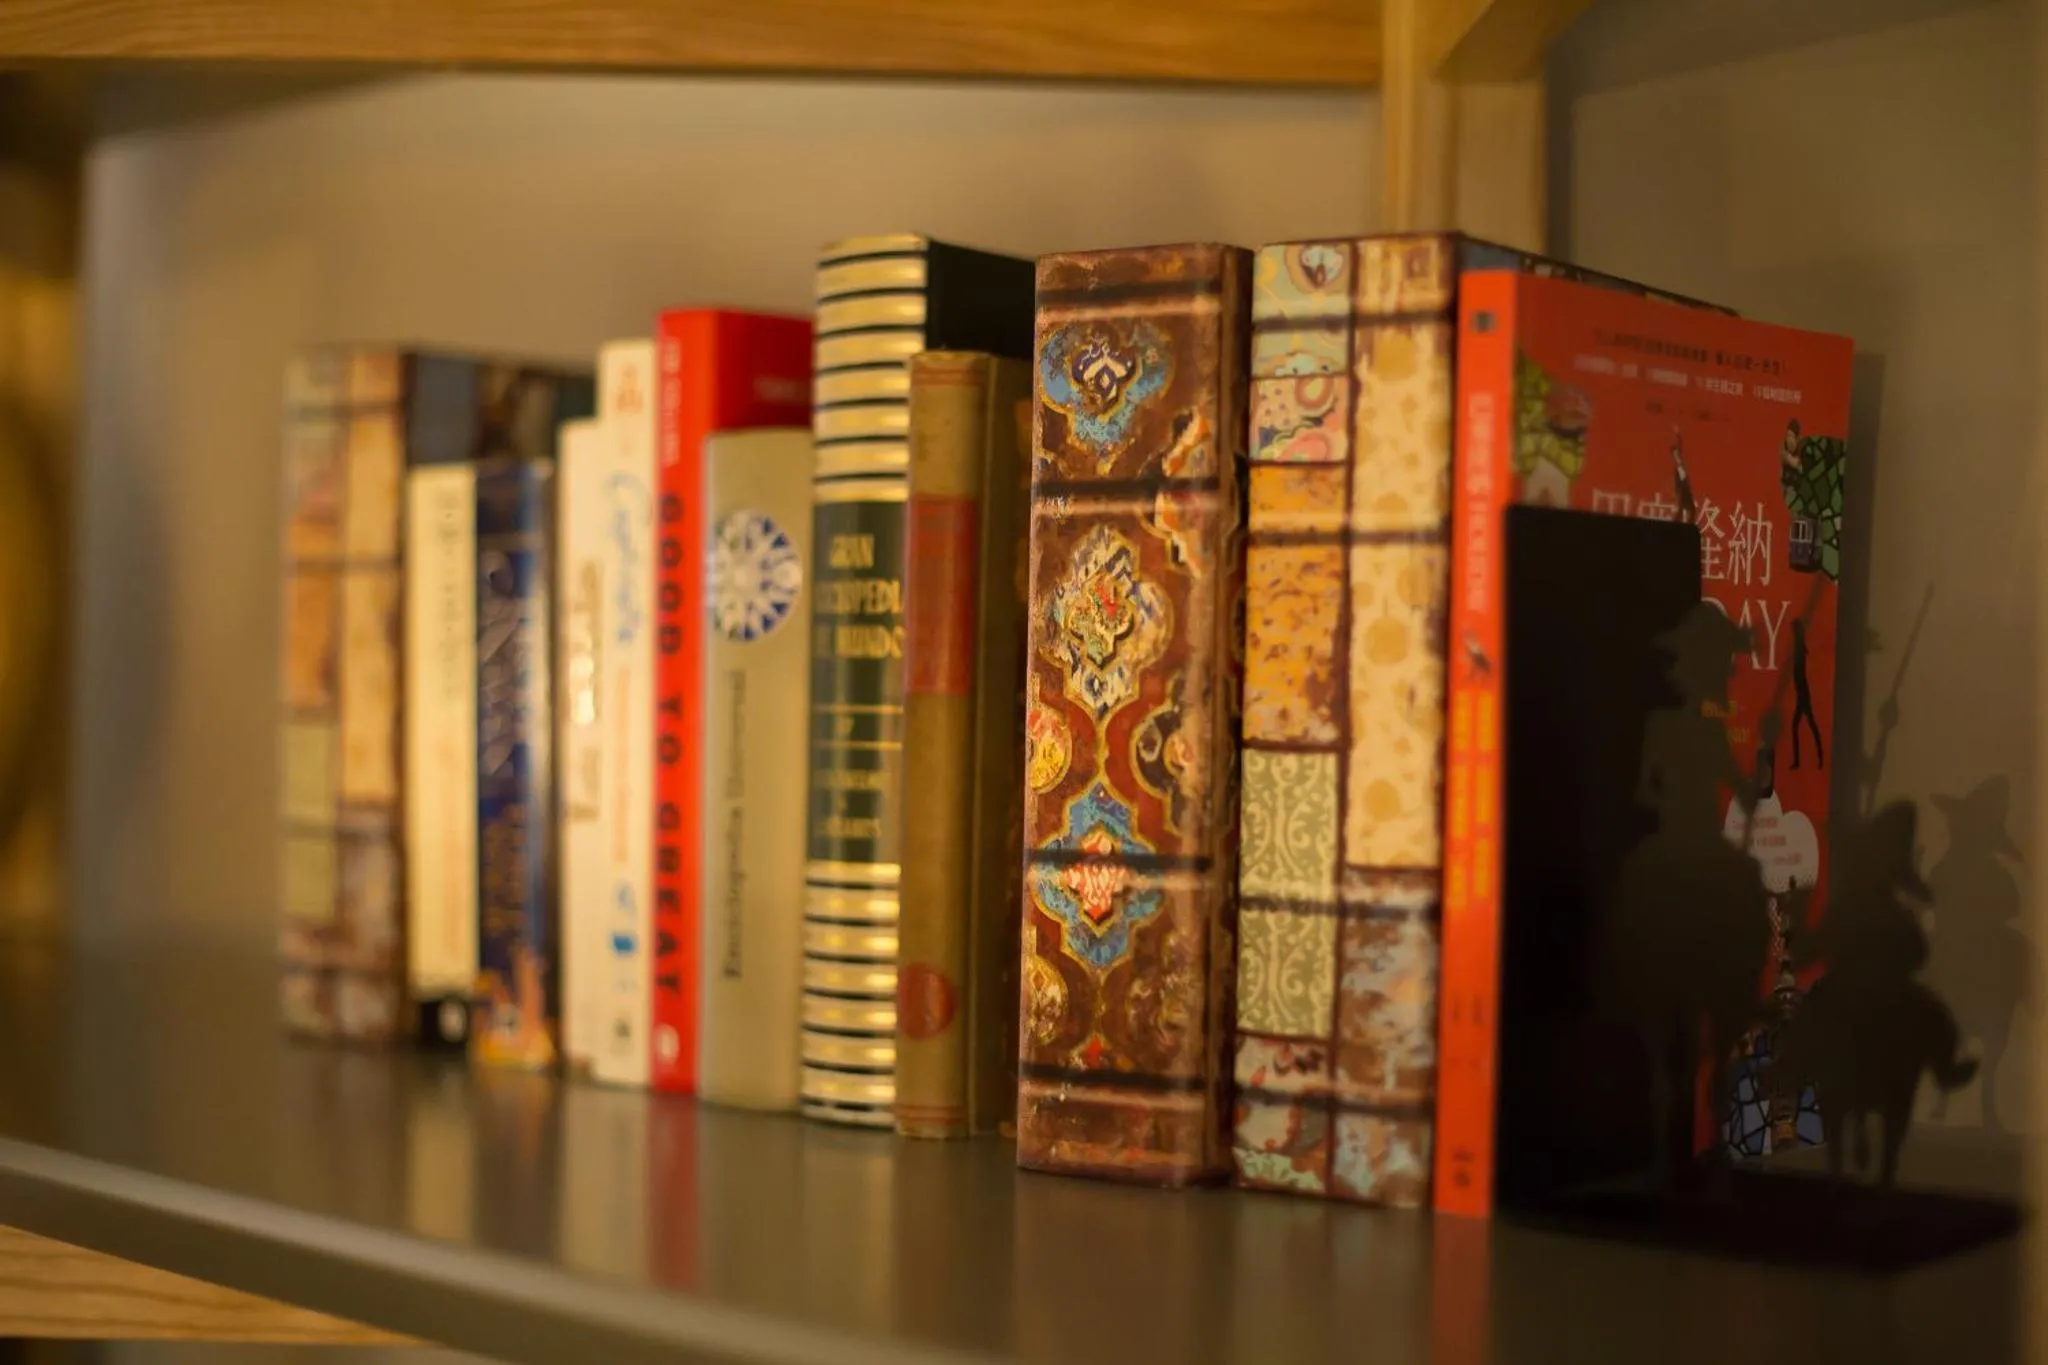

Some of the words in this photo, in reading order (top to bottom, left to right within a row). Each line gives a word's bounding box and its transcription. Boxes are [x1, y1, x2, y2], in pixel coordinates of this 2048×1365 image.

[659, 493, 684, 656] GOOD
[1591, 488, 1774, 587] 隆納
[1701, 597, 1792, 671] AY
[657, 692, 684, 768] TO
[655, 803, 682, 995] GREAT
